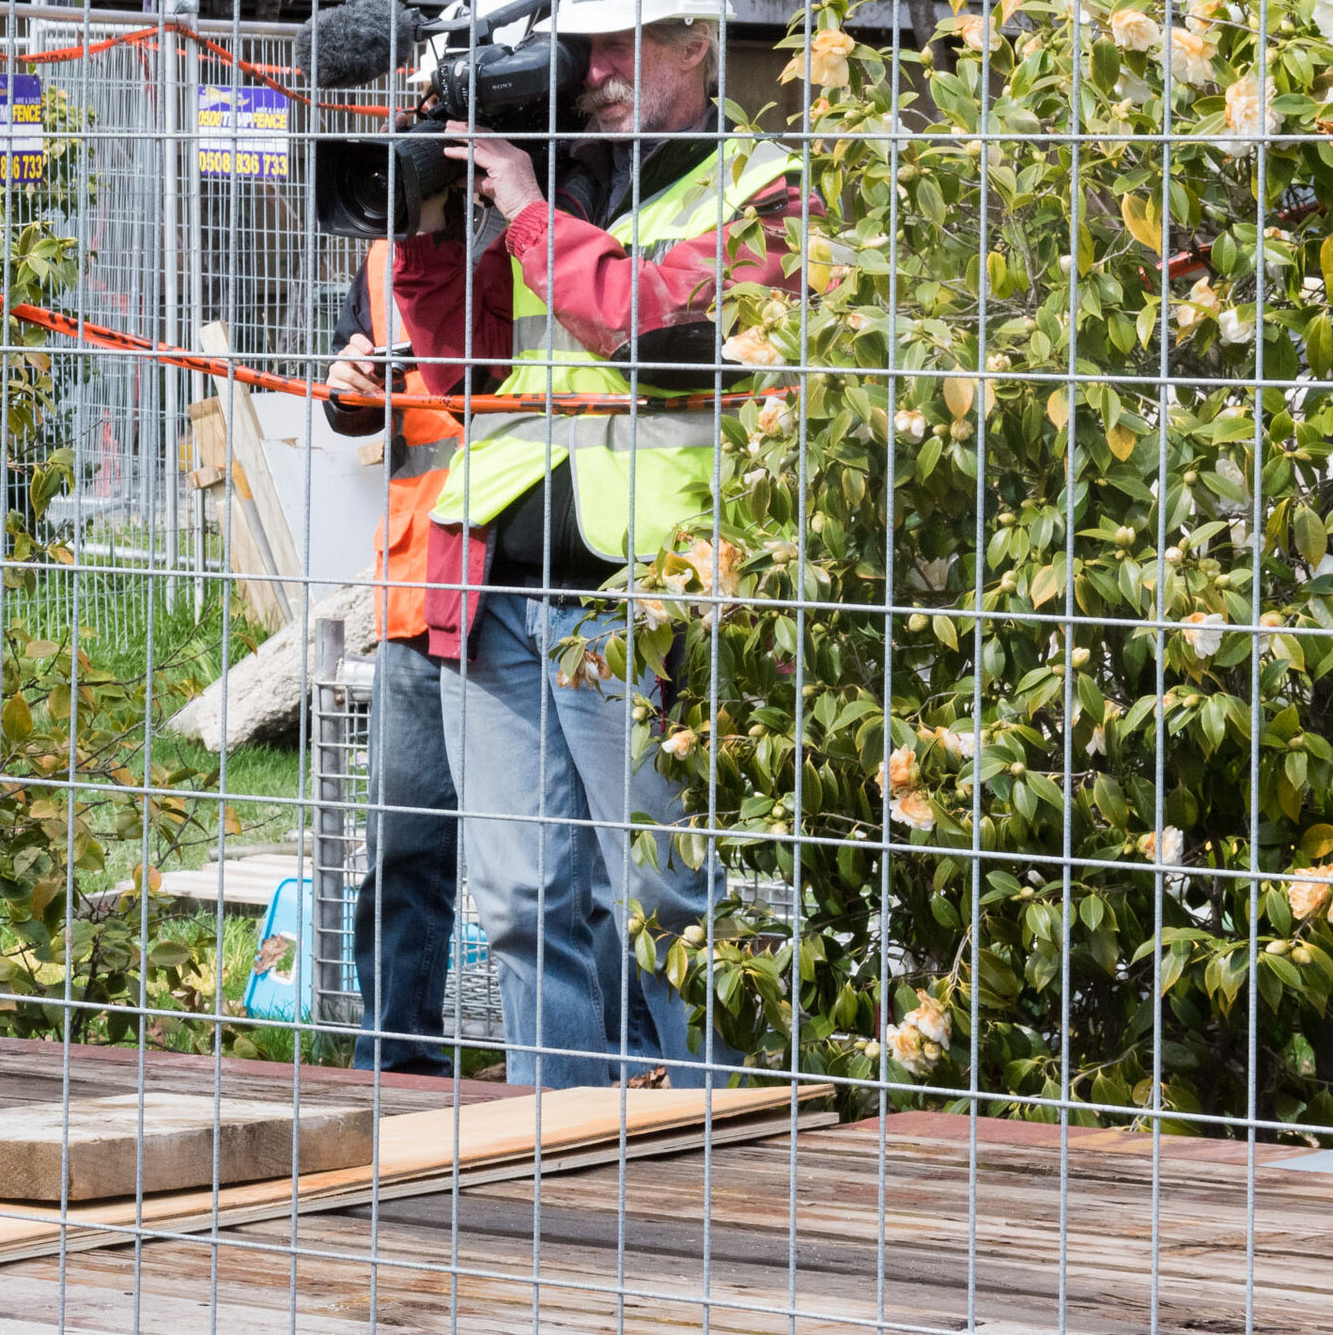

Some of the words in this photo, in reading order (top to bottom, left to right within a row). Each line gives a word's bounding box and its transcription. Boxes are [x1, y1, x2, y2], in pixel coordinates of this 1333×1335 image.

[0, 154, 20, 180] 86
[22, 154, 43, 179] 733
[199, 151, 231, 173] 0508
[263, 154, 287, 176] 733
